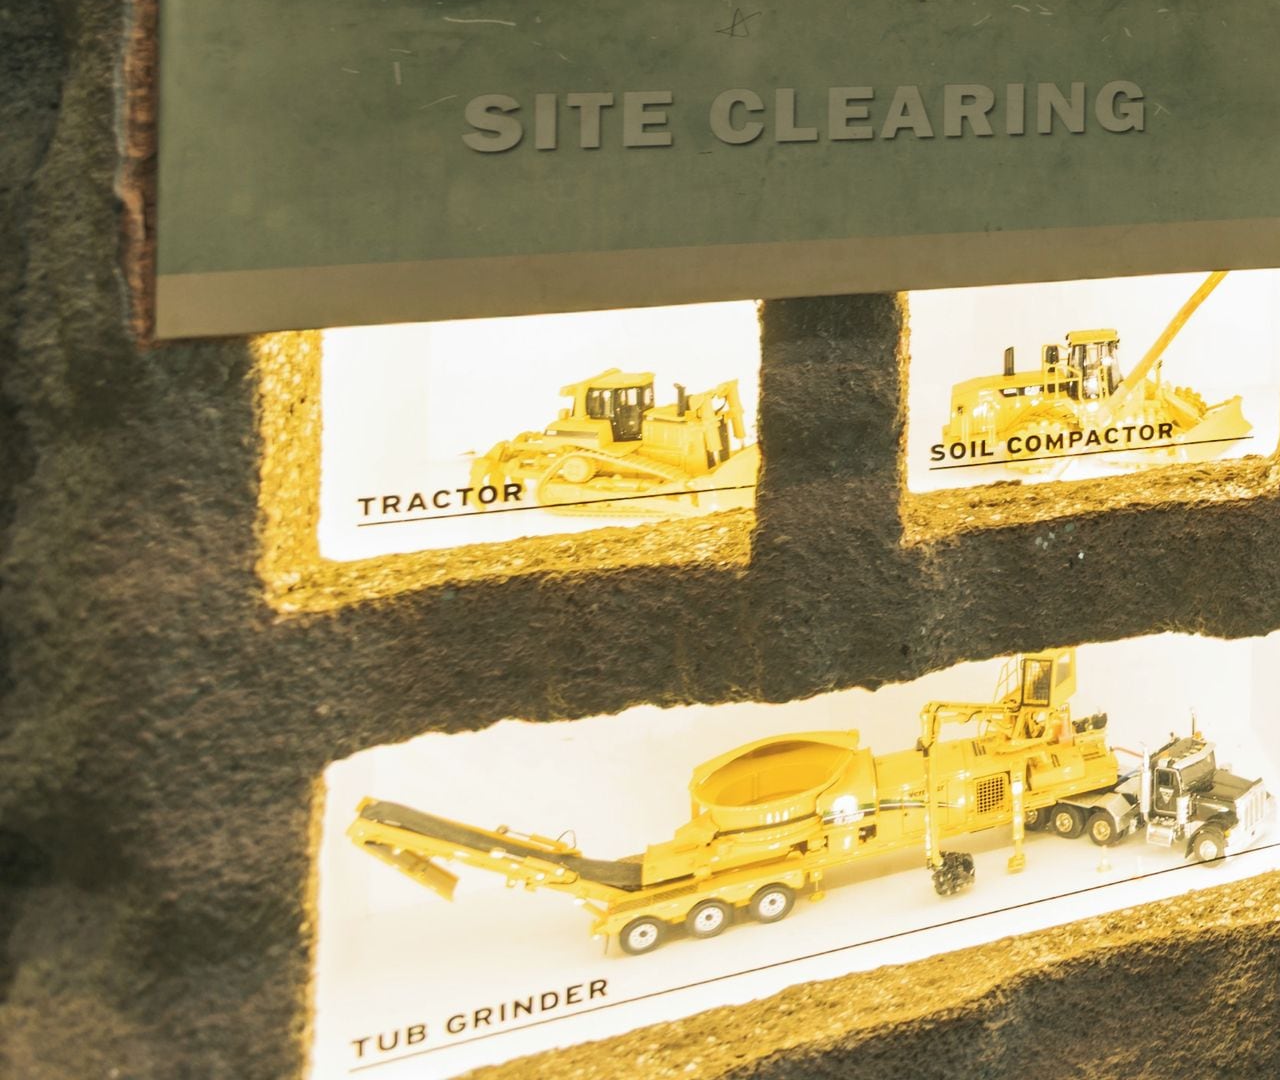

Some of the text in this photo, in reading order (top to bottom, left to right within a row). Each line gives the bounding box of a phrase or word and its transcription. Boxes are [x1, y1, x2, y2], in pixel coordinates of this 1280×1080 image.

[461, 78, 1146, 155] SITE CLEARING
[930, 422, 1175, 462] SOIL COMPACTOR
[357, 482, 524, 517] TRACTOR
[351, 978, 609, 1058] TUB GRINDER
